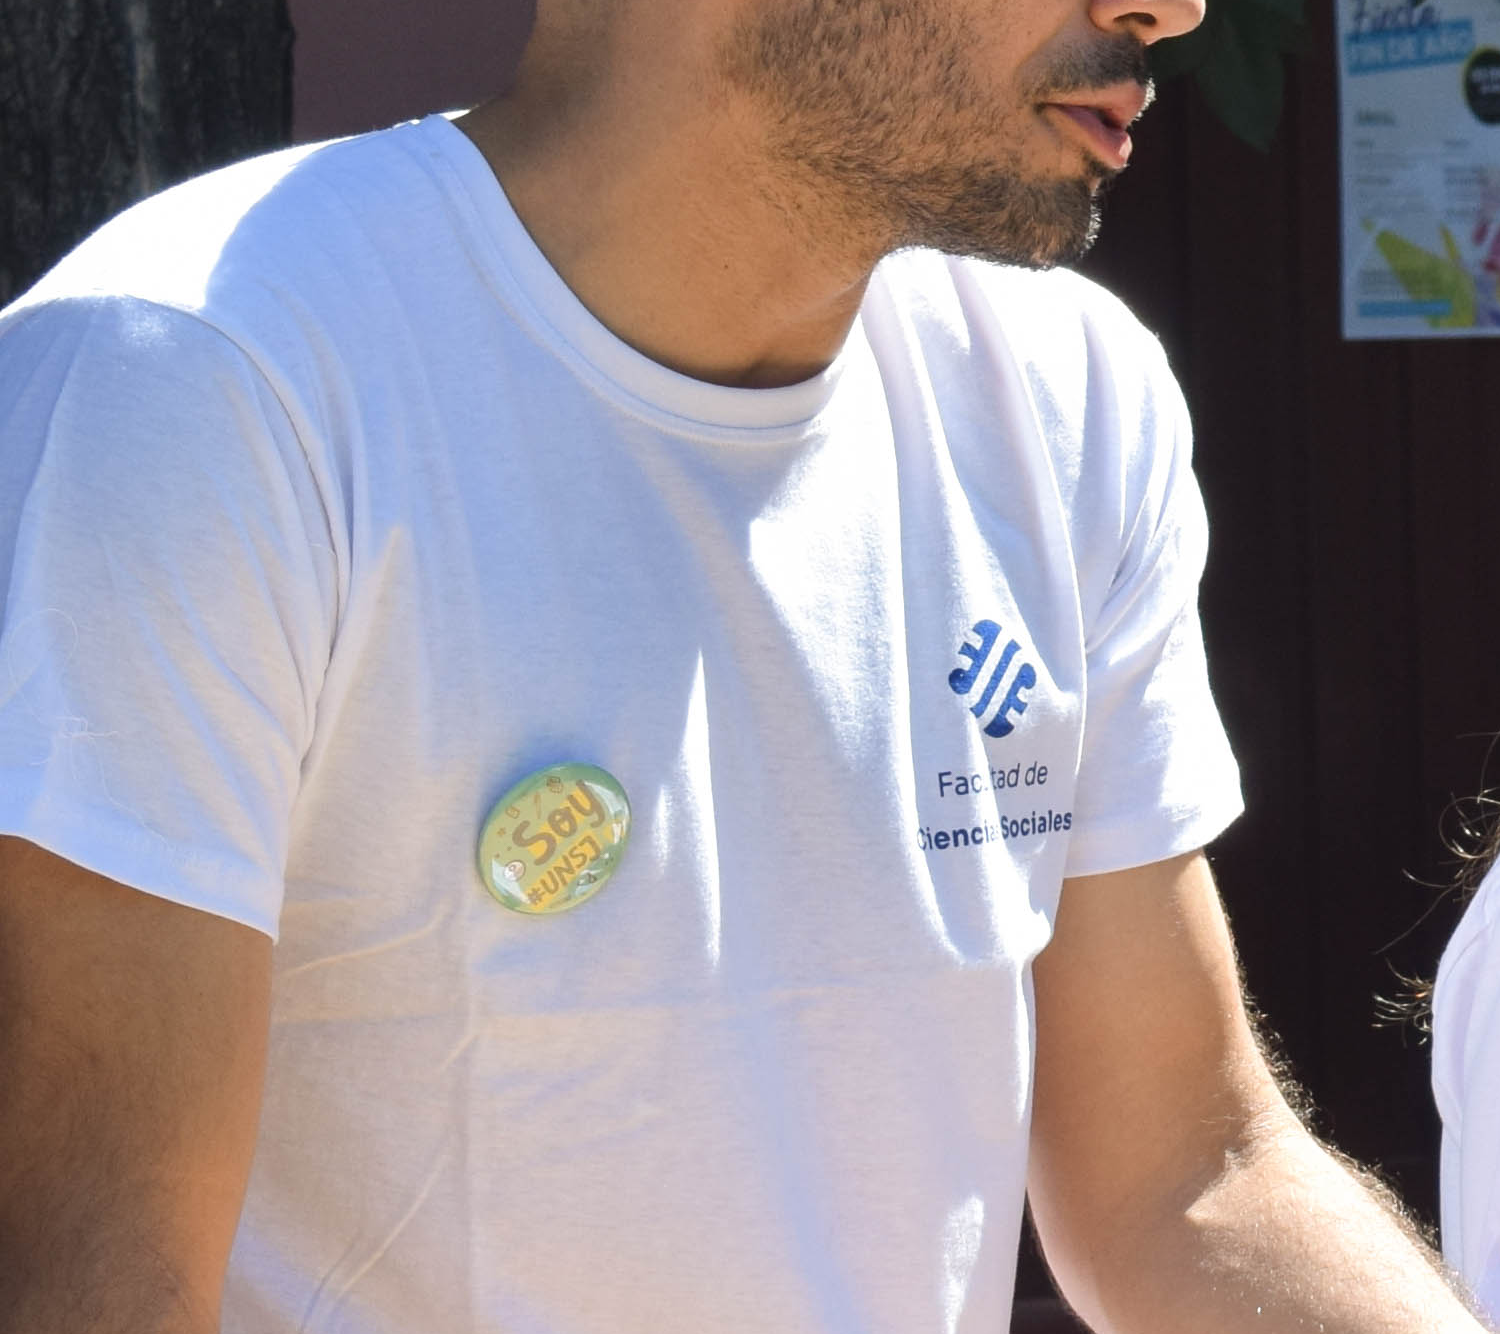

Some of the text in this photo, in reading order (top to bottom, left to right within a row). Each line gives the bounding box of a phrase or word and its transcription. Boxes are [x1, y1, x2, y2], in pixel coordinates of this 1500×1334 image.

[938, 761, 1048, 797] Factad de
[512, 779, 606, 866] Soy
[1001, 809, 1073, 840] Sociales
[527, 835, 601, 906] #UNSJ
